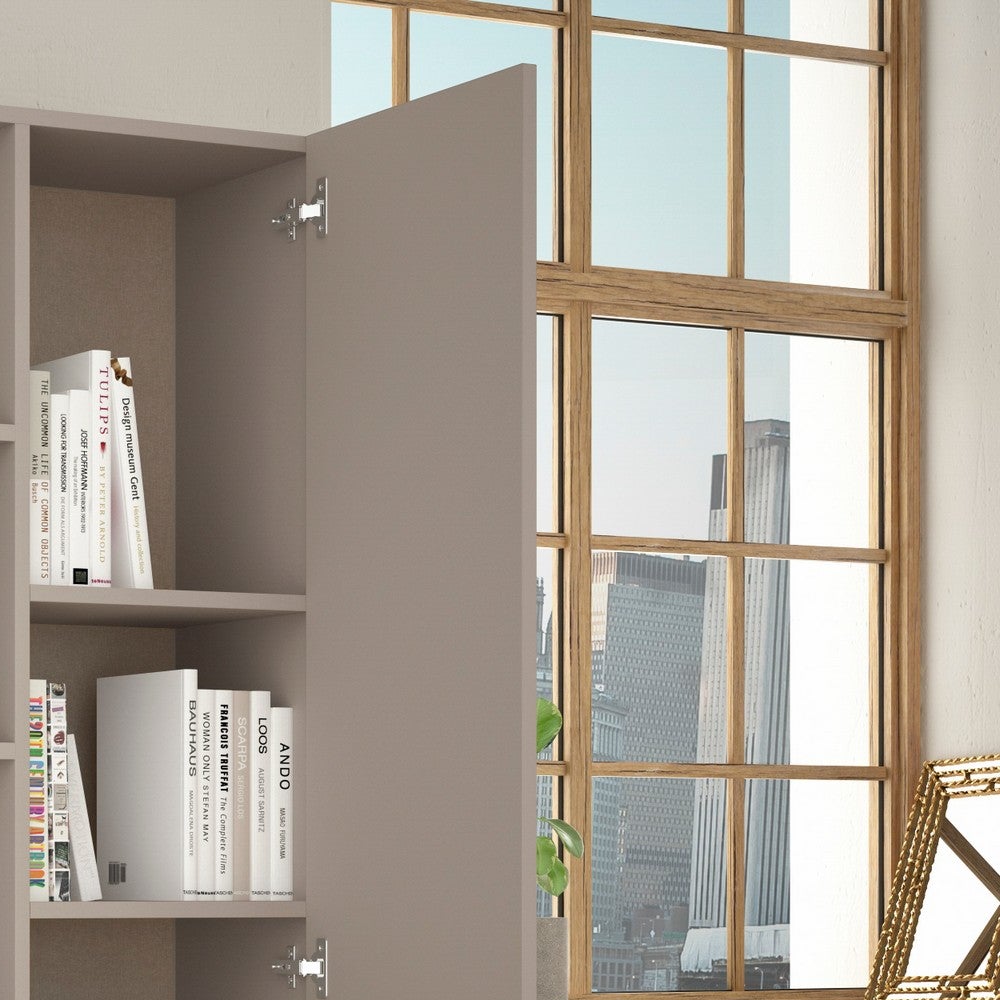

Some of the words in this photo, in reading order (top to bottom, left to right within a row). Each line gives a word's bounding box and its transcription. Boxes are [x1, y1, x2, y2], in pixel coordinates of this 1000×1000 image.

[99, 367, 109, 435] TULIPS
[121, 398, 132, 431] Design
[126, 433, 137, 474] museum
[41, 482, 48, 491] OF
[99, 466, 106, 480] BY
[130, 476, 140, 500] Gent
[220, 704, 228, 749] FRANCOIS
[238, 717, 247, 770] SCARPA
[259, 718, 267, 754] LOOS
[220, 754, 228, 792] TRUFFAT
[280, 743, 290, 790] ANDO
